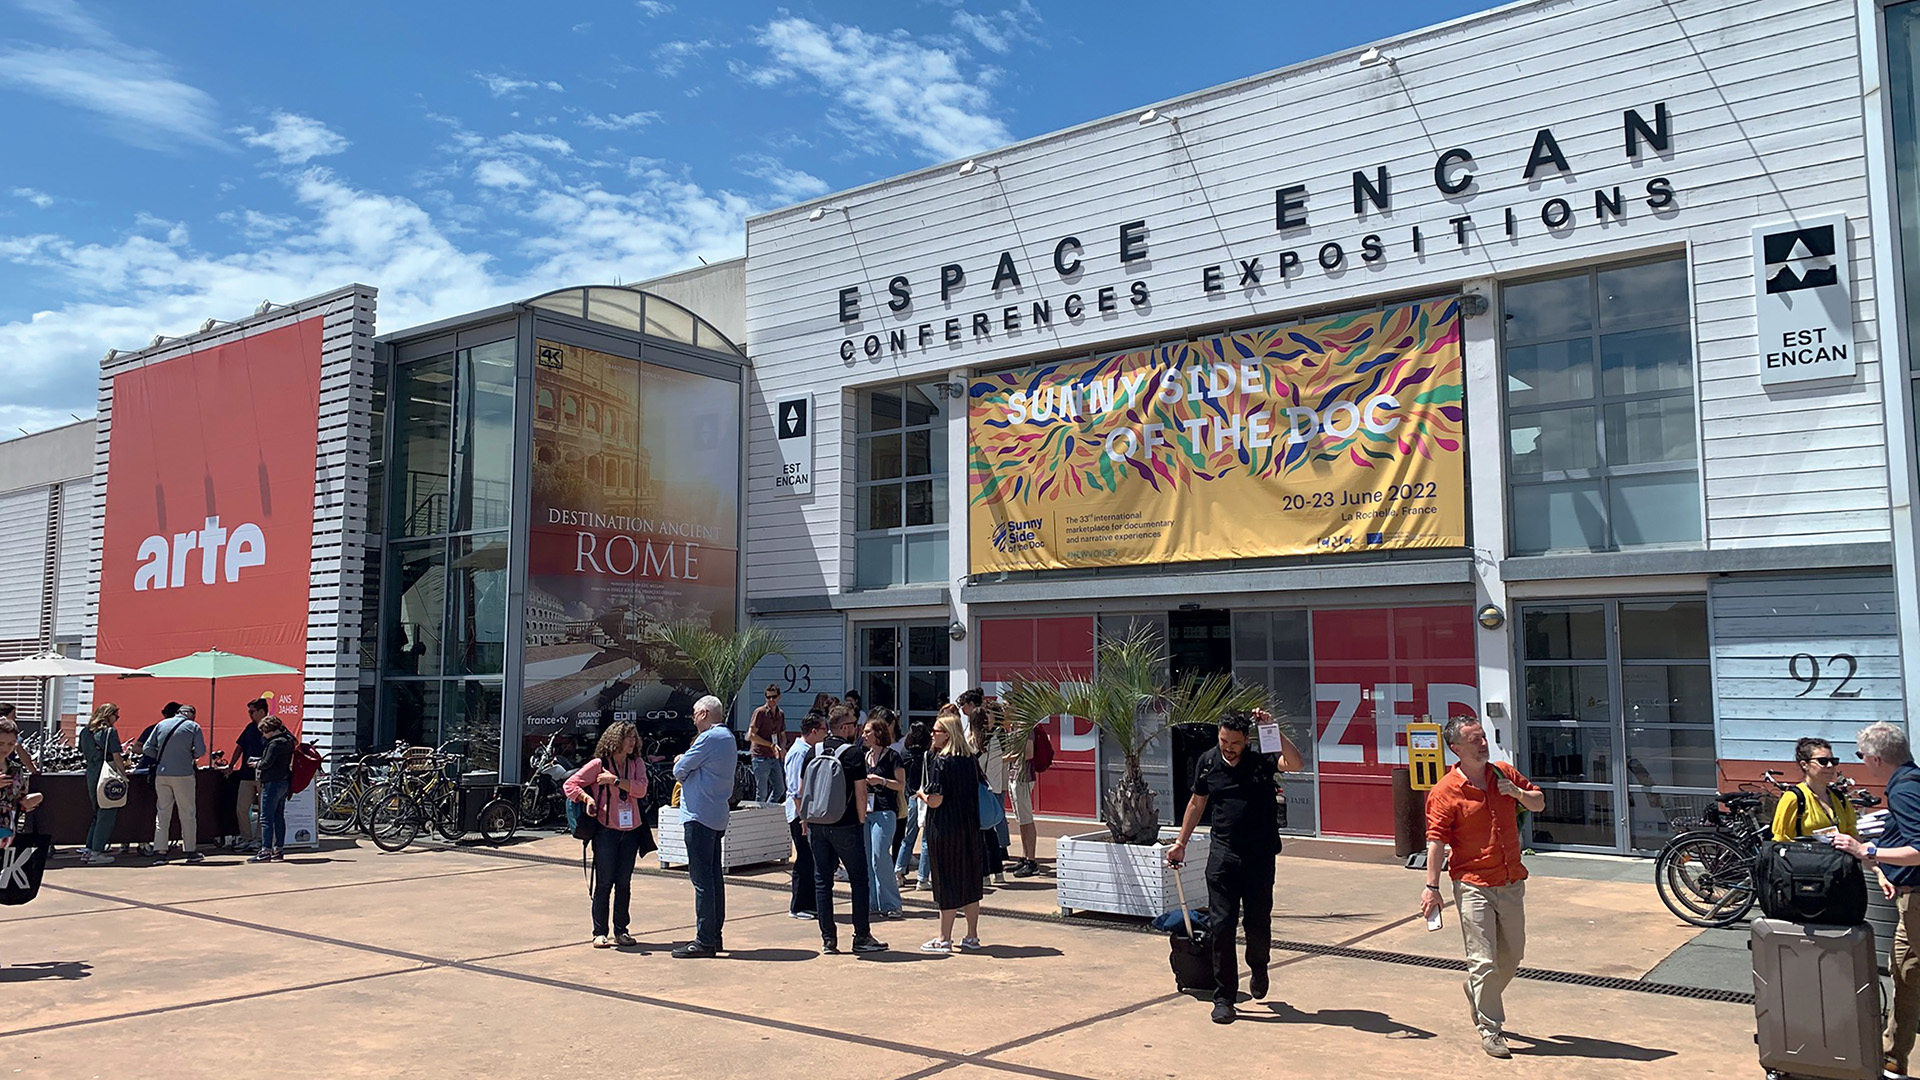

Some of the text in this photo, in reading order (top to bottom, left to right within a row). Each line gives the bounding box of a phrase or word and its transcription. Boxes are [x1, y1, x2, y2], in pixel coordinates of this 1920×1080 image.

[839, 102, 1668, 322] ESPACE ENCAN
[840, 177, 1673, 361] CONFERENCES EXPOSITIONS
[1783, 328, 1827, 348] EST
[541, 349, 561, 364] 4K
[1767, 344, 1848, 369] ENCAN
[1007, 356, 1264, 425] SUNNY SIDE
[1105, 394, 1401, 463] OF THE DOC
[783, 463, 801, 475] EST
[776, 474, 809, 487] ENCAN
[1282, 482, 1437, 511] 20-23 June 2022
[1066, 516, 1078, 524] The
[1094, 511, 1142, 522] international
[1341, 512, 1353, 522] La
[1402, 505, 1437, 516] France
[548, 507, 722, 541] DESTINATION ANCIENT
[1007, 517, 1043, 532] Sunny
[1066, 519, 1175, 534] marketplace for documentary
[1009, 530, 1035, 544] Side
[1066, 530, 1162, 544] and narrative experiences
[133, 515, 267, 592] arte
[574, 530, 700, 580] ROME
[1008, 544, 1017, 553] of
[1029, 541, 1045, 549] Doc
[783, 663, 811, 693] 93
[1788, 652, 1864, 698] 92
[279, 694, 292, 704] ANS
[279, 705, 299, 715] JAHRE
